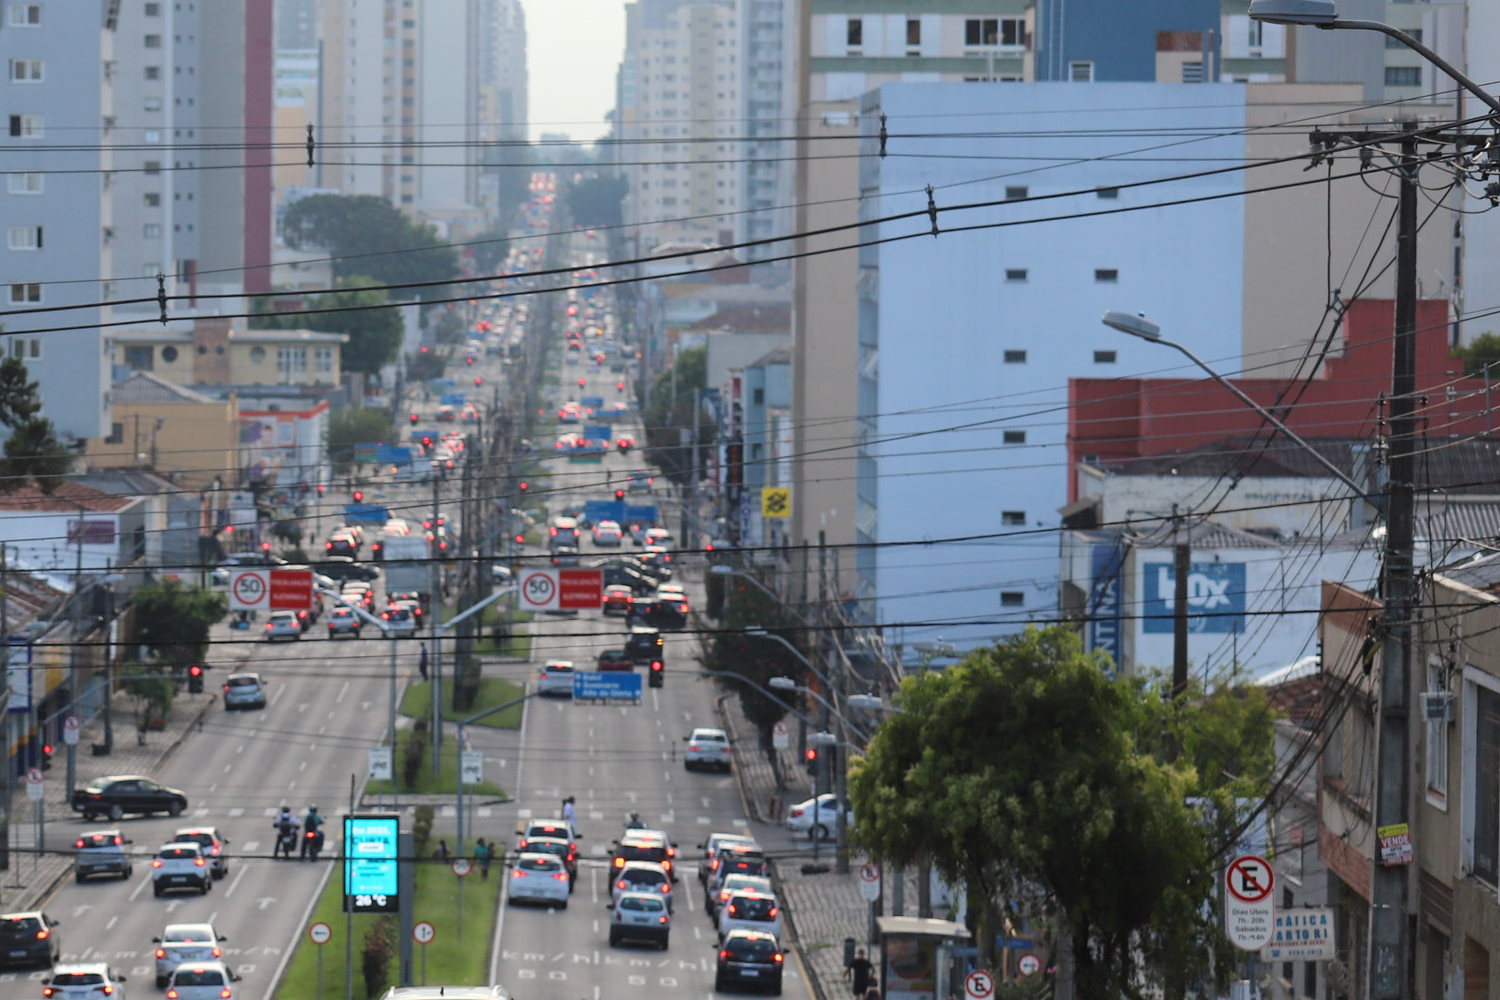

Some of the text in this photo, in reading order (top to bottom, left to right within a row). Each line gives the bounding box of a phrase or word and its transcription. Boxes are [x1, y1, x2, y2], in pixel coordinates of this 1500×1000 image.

[241, 579, 260, 592] 50
[530, 581, 549, 593] 50
[1380, 834, 1409, 848] VENDE
[518, 968, 566, 980] 50
[628, 975, 677, 986] 50
